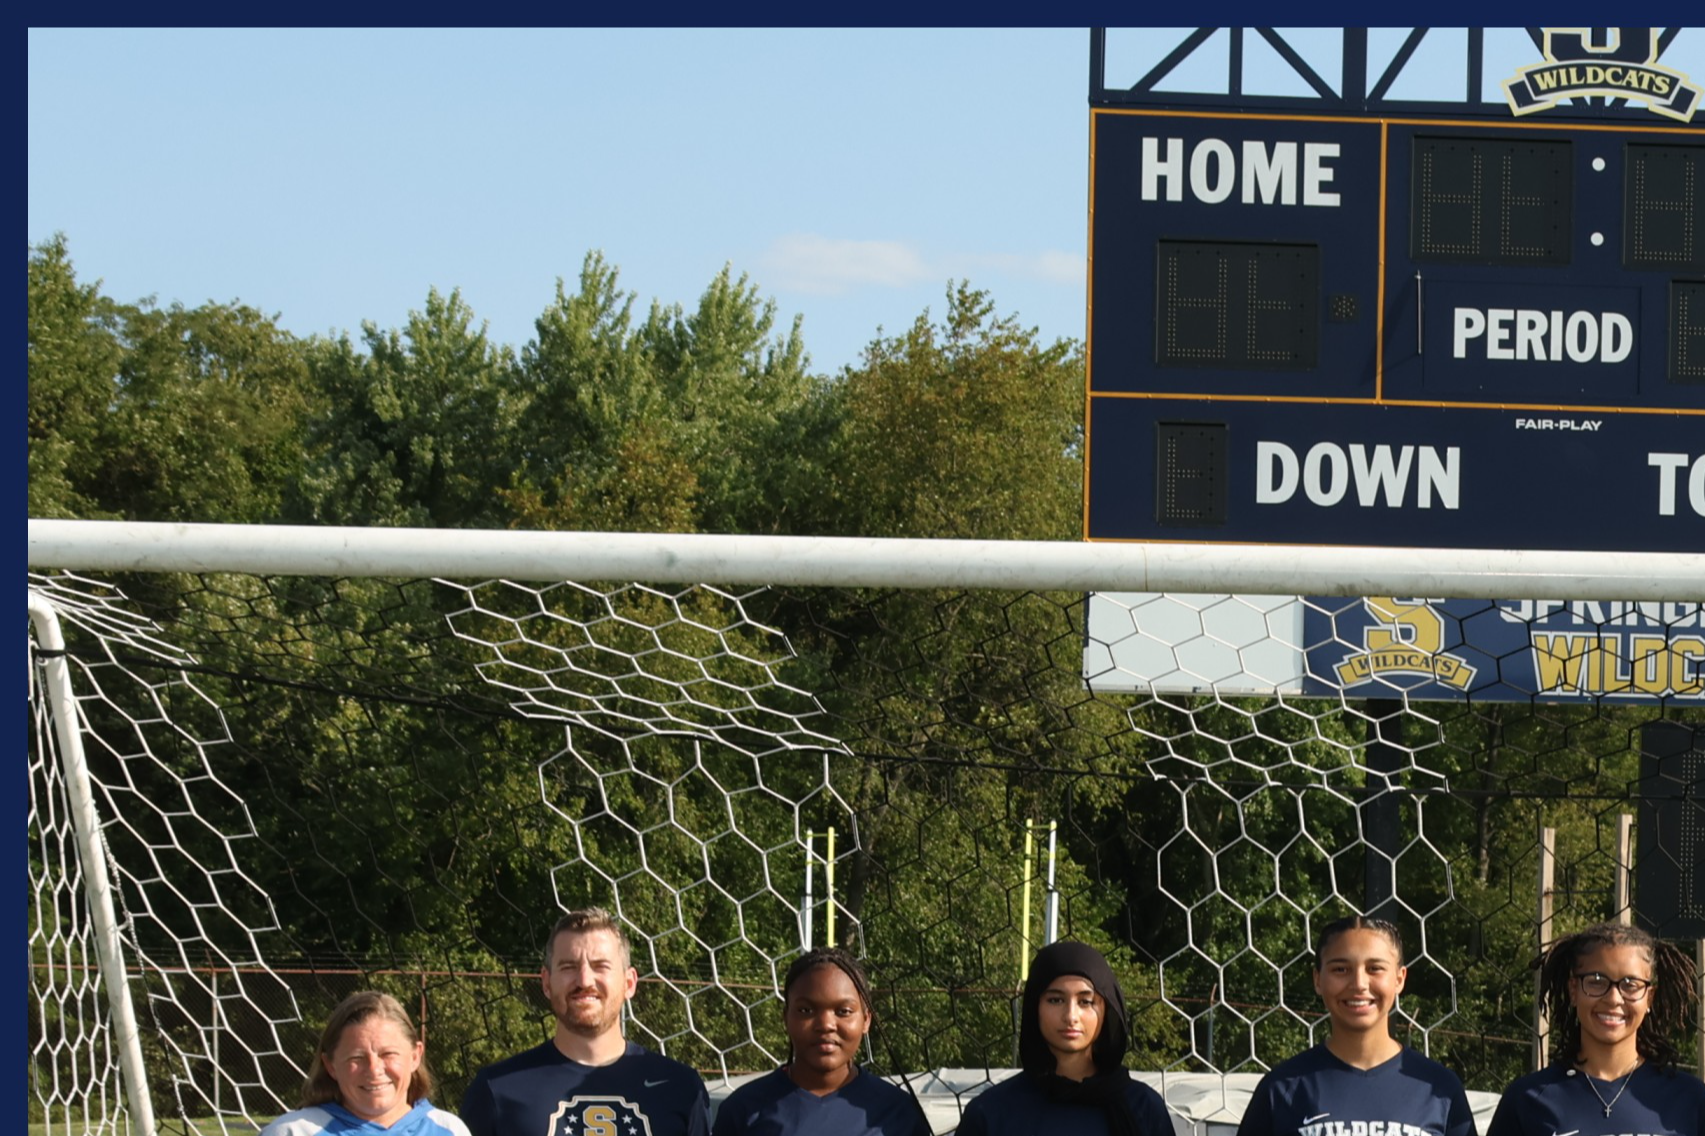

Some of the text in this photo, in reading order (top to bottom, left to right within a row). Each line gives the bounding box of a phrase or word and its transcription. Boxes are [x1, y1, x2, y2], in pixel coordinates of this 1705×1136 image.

[1533, 66, 1671, 95] WILDCATS
[1141, 136, 1341, 207] HOME
[1453, 307, 1634, 363] PERIOD
[1515, 418, 1603, 431] FAIR-PLAY
[1255, 440, 1461, 510] DOWN
[1356, 653, 1454, 674] WILDCATS
